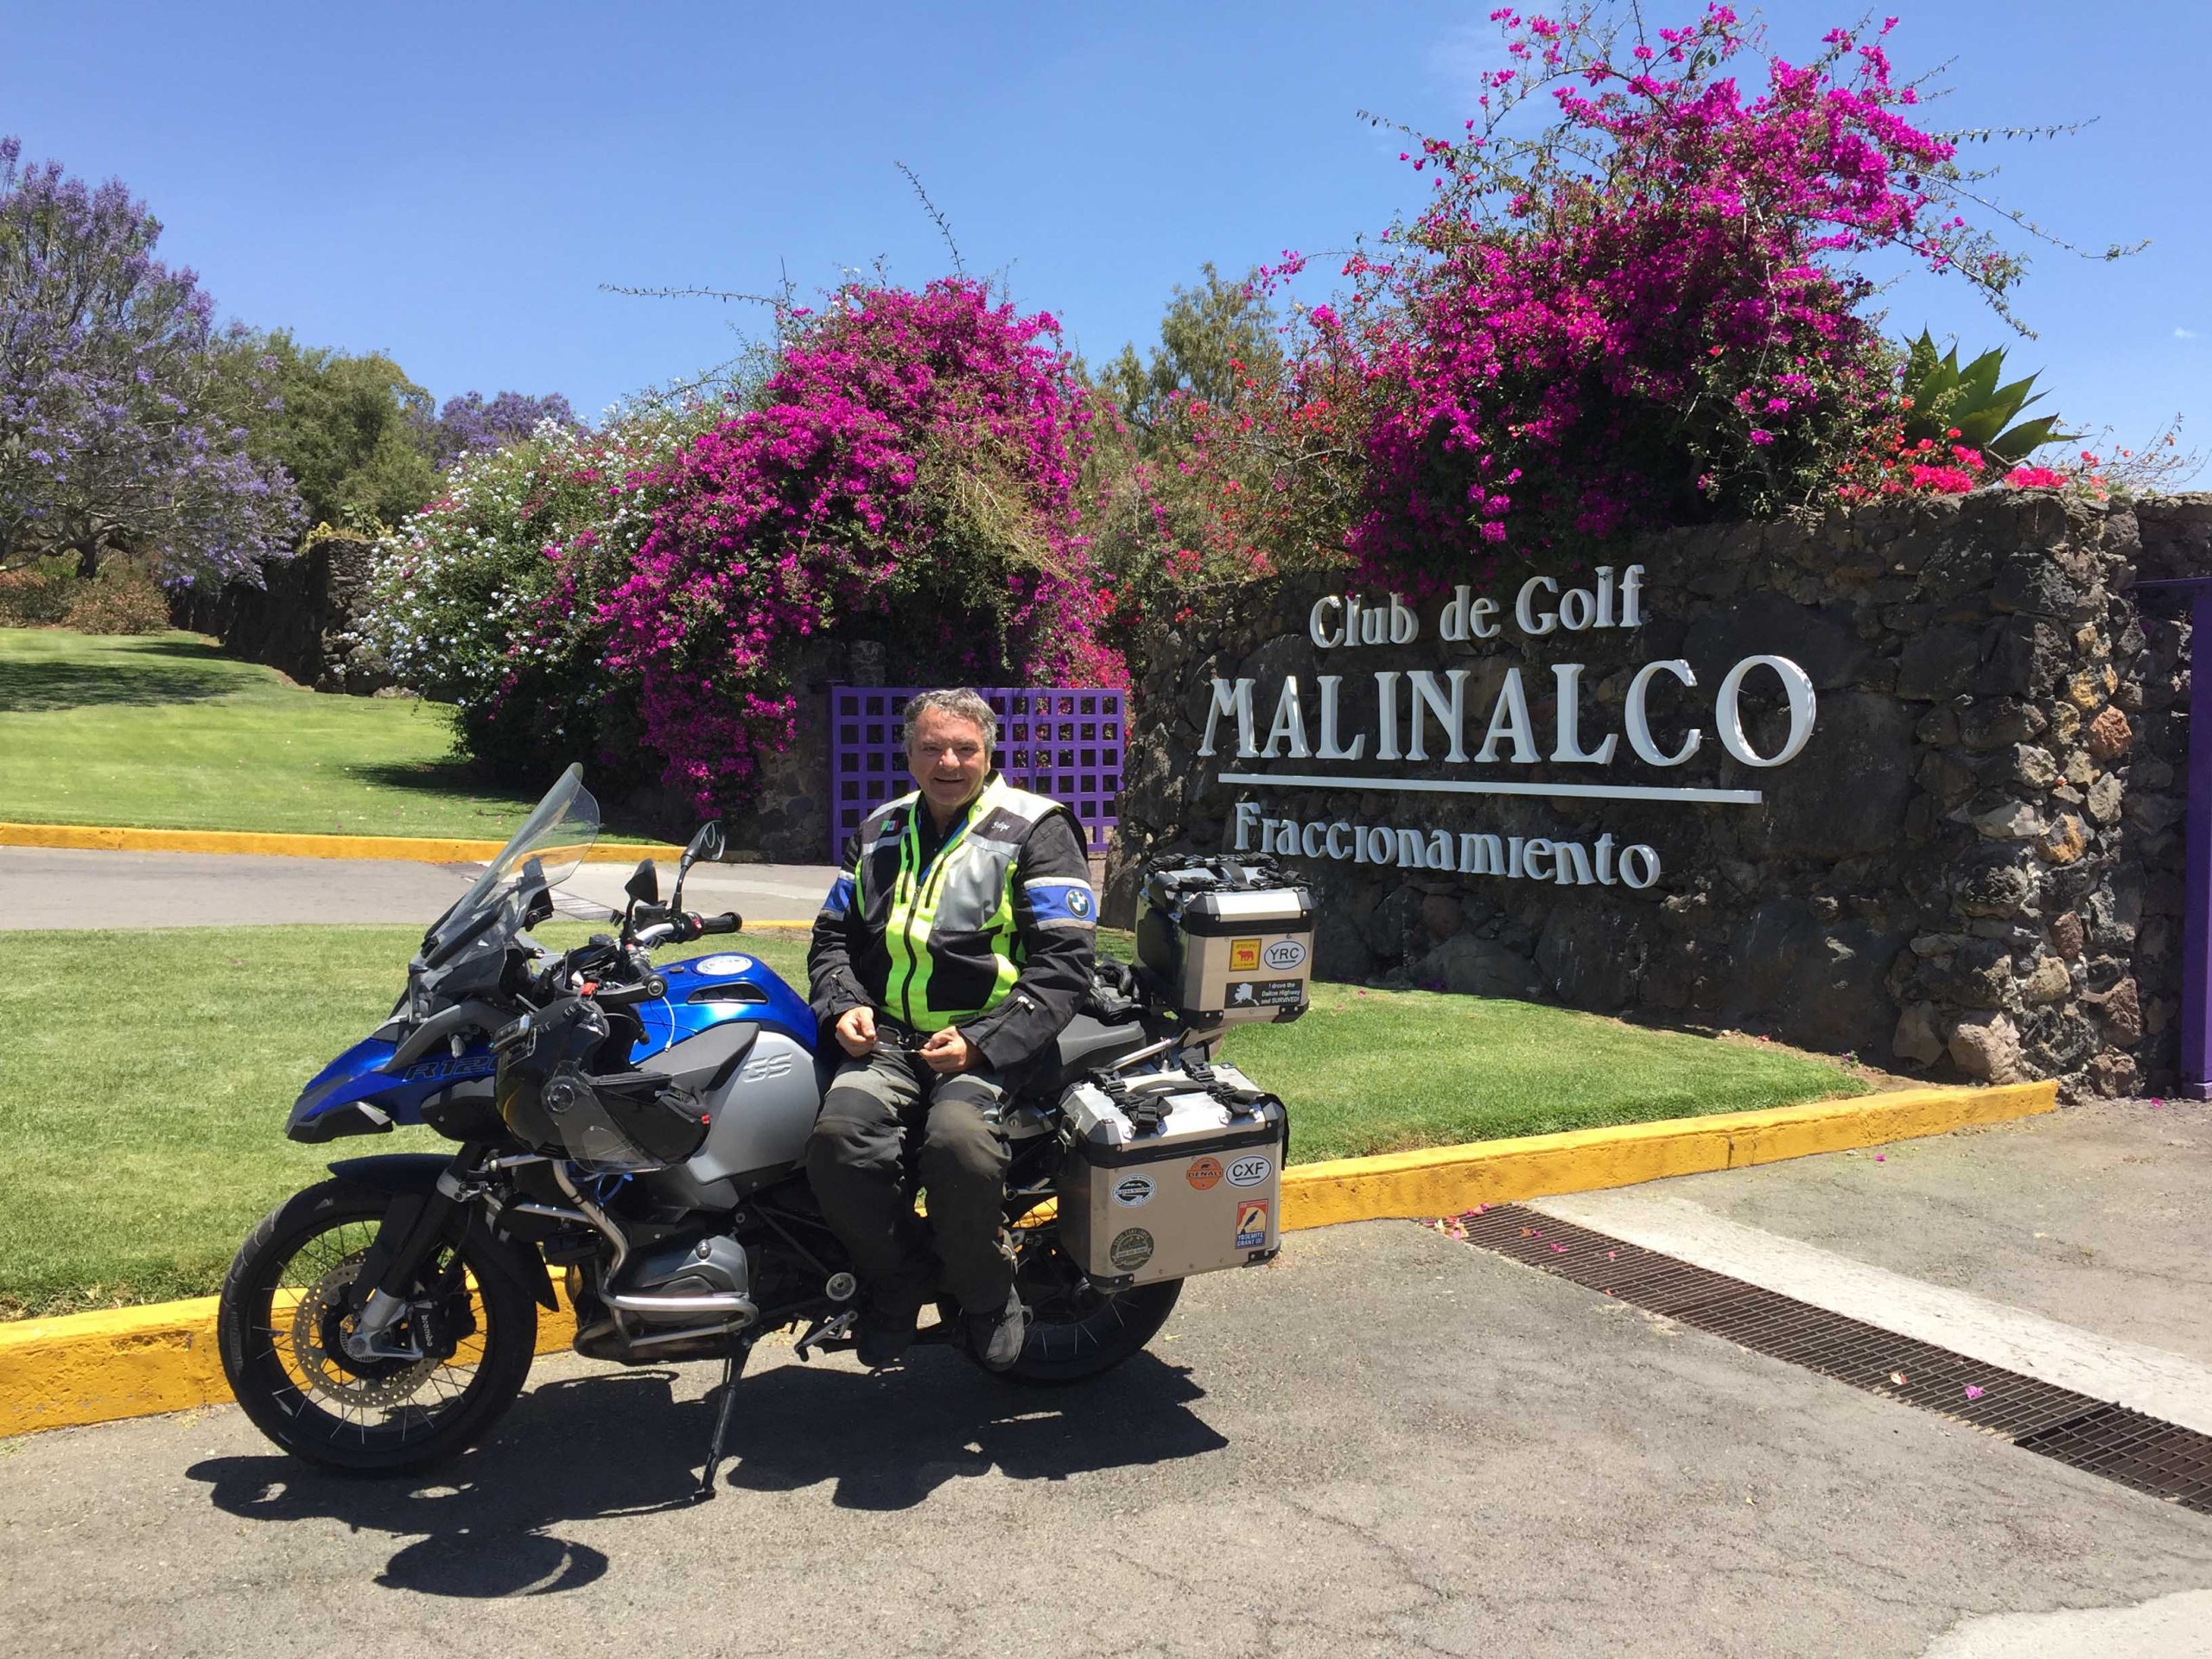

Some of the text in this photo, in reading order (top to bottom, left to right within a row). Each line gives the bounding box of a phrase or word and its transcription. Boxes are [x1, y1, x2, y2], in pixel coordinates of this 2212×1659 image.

[1309, 564, 1644, 648] Club de Golf
[1198, 654, 1816, 767] MALINALCO
[1235, 801, 1661, 889] Fraccionamiento
[1270, 947, 1300, 960] YRC
[743, 1052, 792, 1083] GS
[1187, 1168, 1222, 1179] DENALI
[1232, 1161, 1265, 1178] CXF
[421, 1314, 433, 1347] brembo
